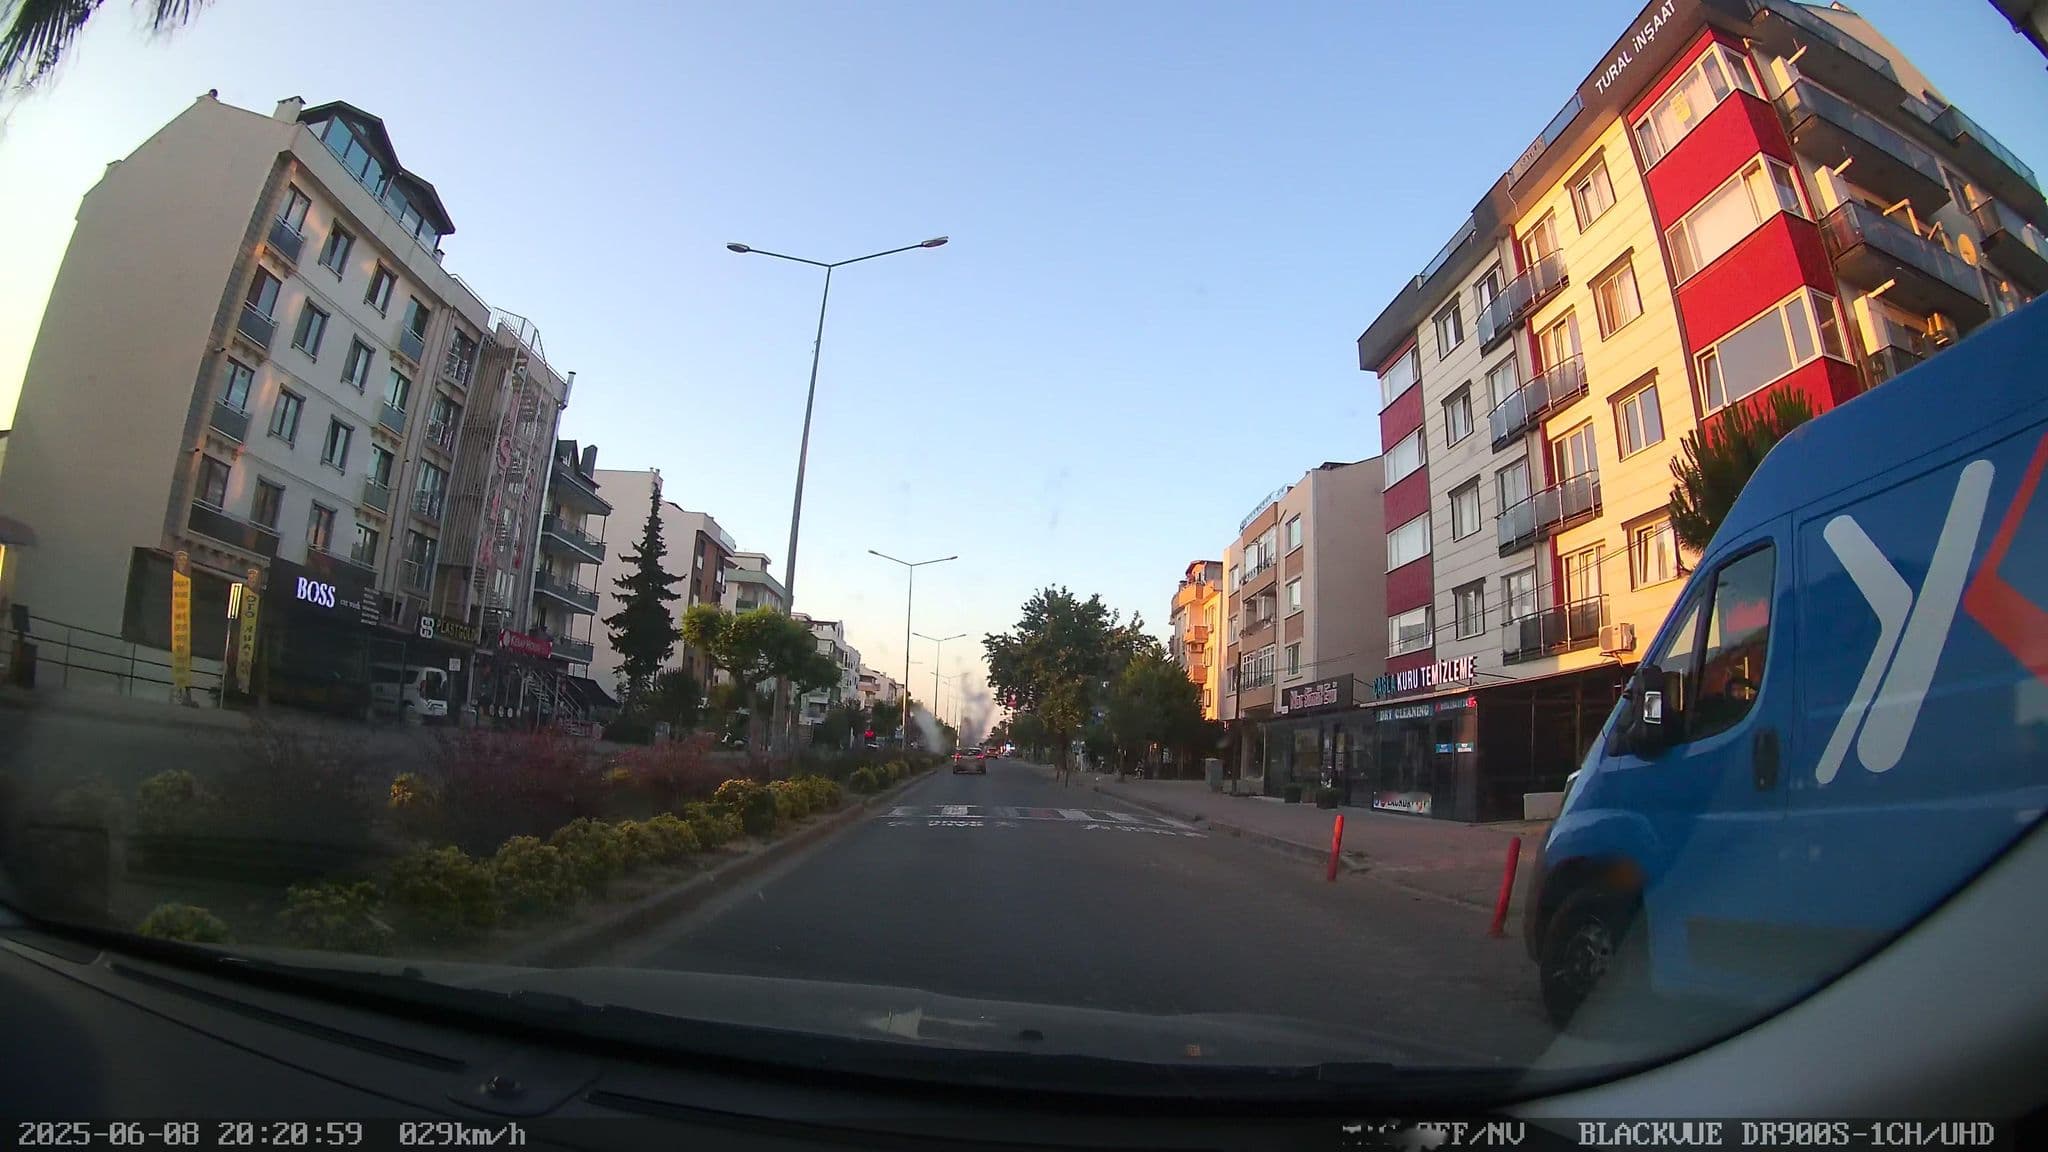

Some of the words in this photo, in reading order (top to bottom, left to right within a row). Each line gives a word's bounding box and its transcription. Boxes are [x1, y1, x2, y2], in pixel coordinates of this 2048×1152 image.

[1595, 51, 1632, 95] TURAL
[297, 576, 336, 608] BOSS
[1397, 669, 1418, 691] KURU
[1420, 655, 1474, 687] TEMİZLEME
[1395, 705, 1429, 719] CLEANING
